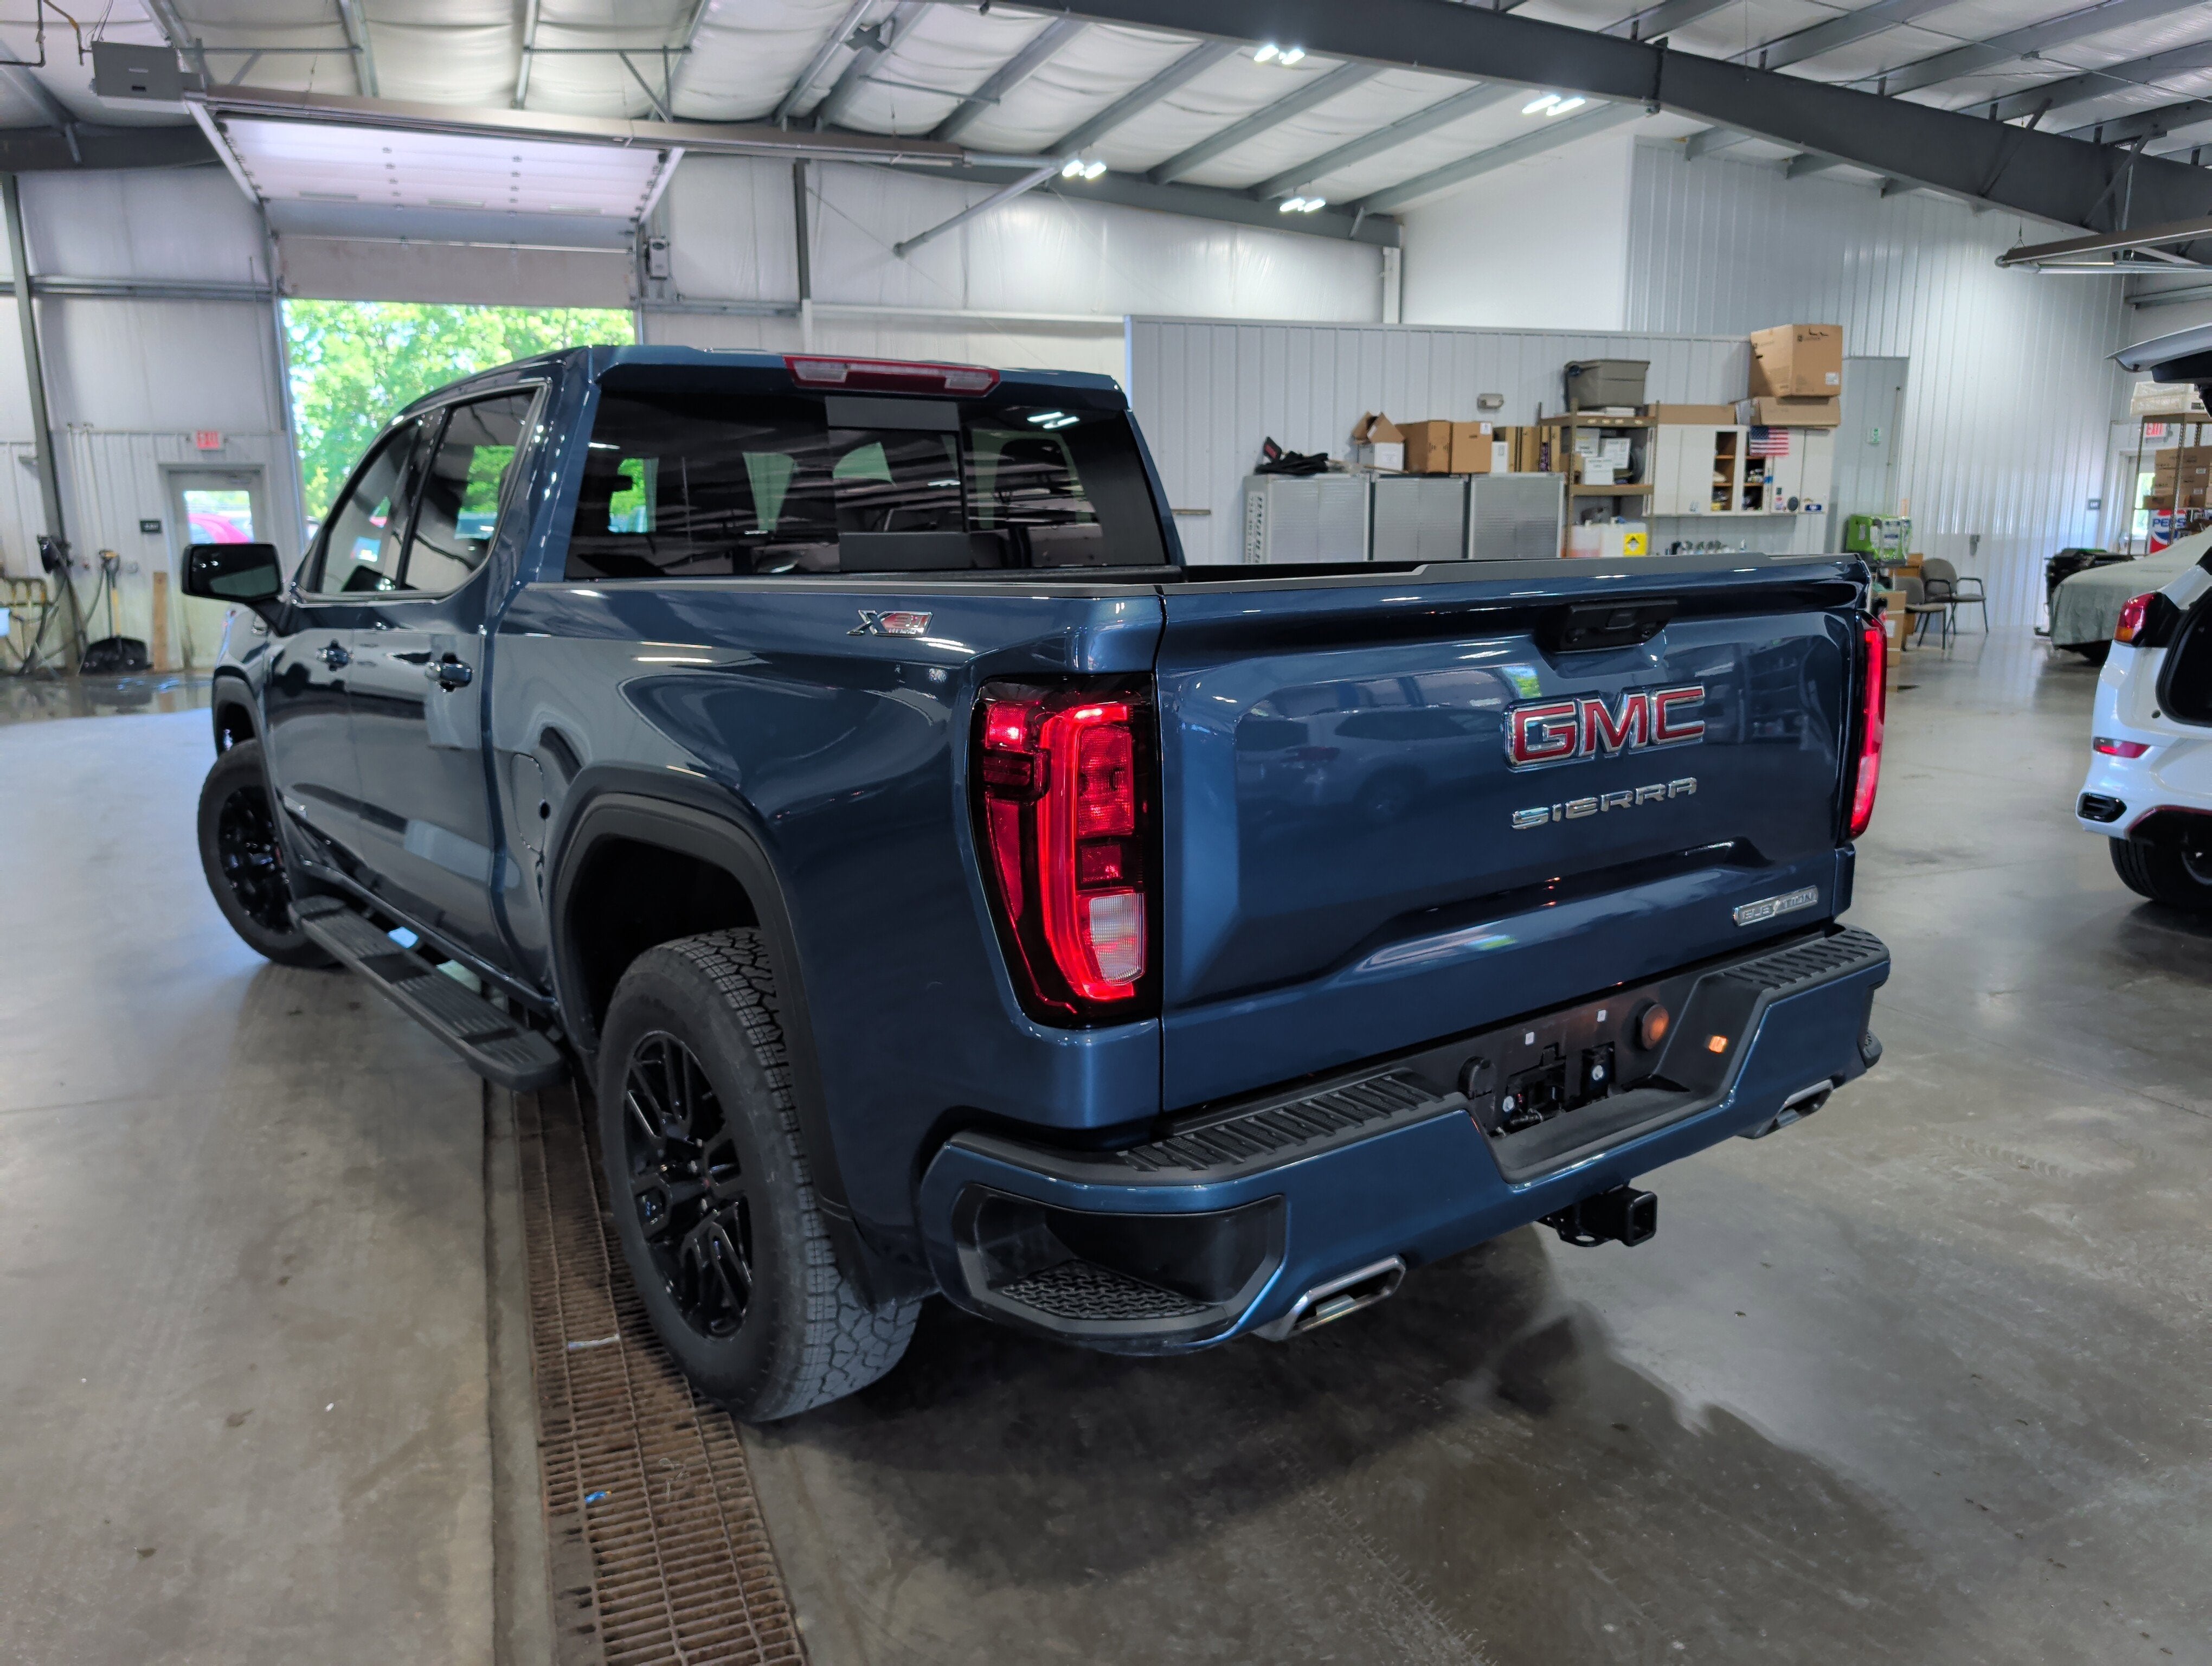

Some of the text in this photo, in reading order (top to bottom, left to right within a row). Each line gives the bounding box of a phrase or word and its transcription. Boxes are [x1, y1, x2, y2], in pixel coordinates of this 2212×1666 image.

[2152, 518, 2186, 528] PES
[1503, 685, 1706, 771] GMC
[1512, 777, 1697, 830] SIERRA
